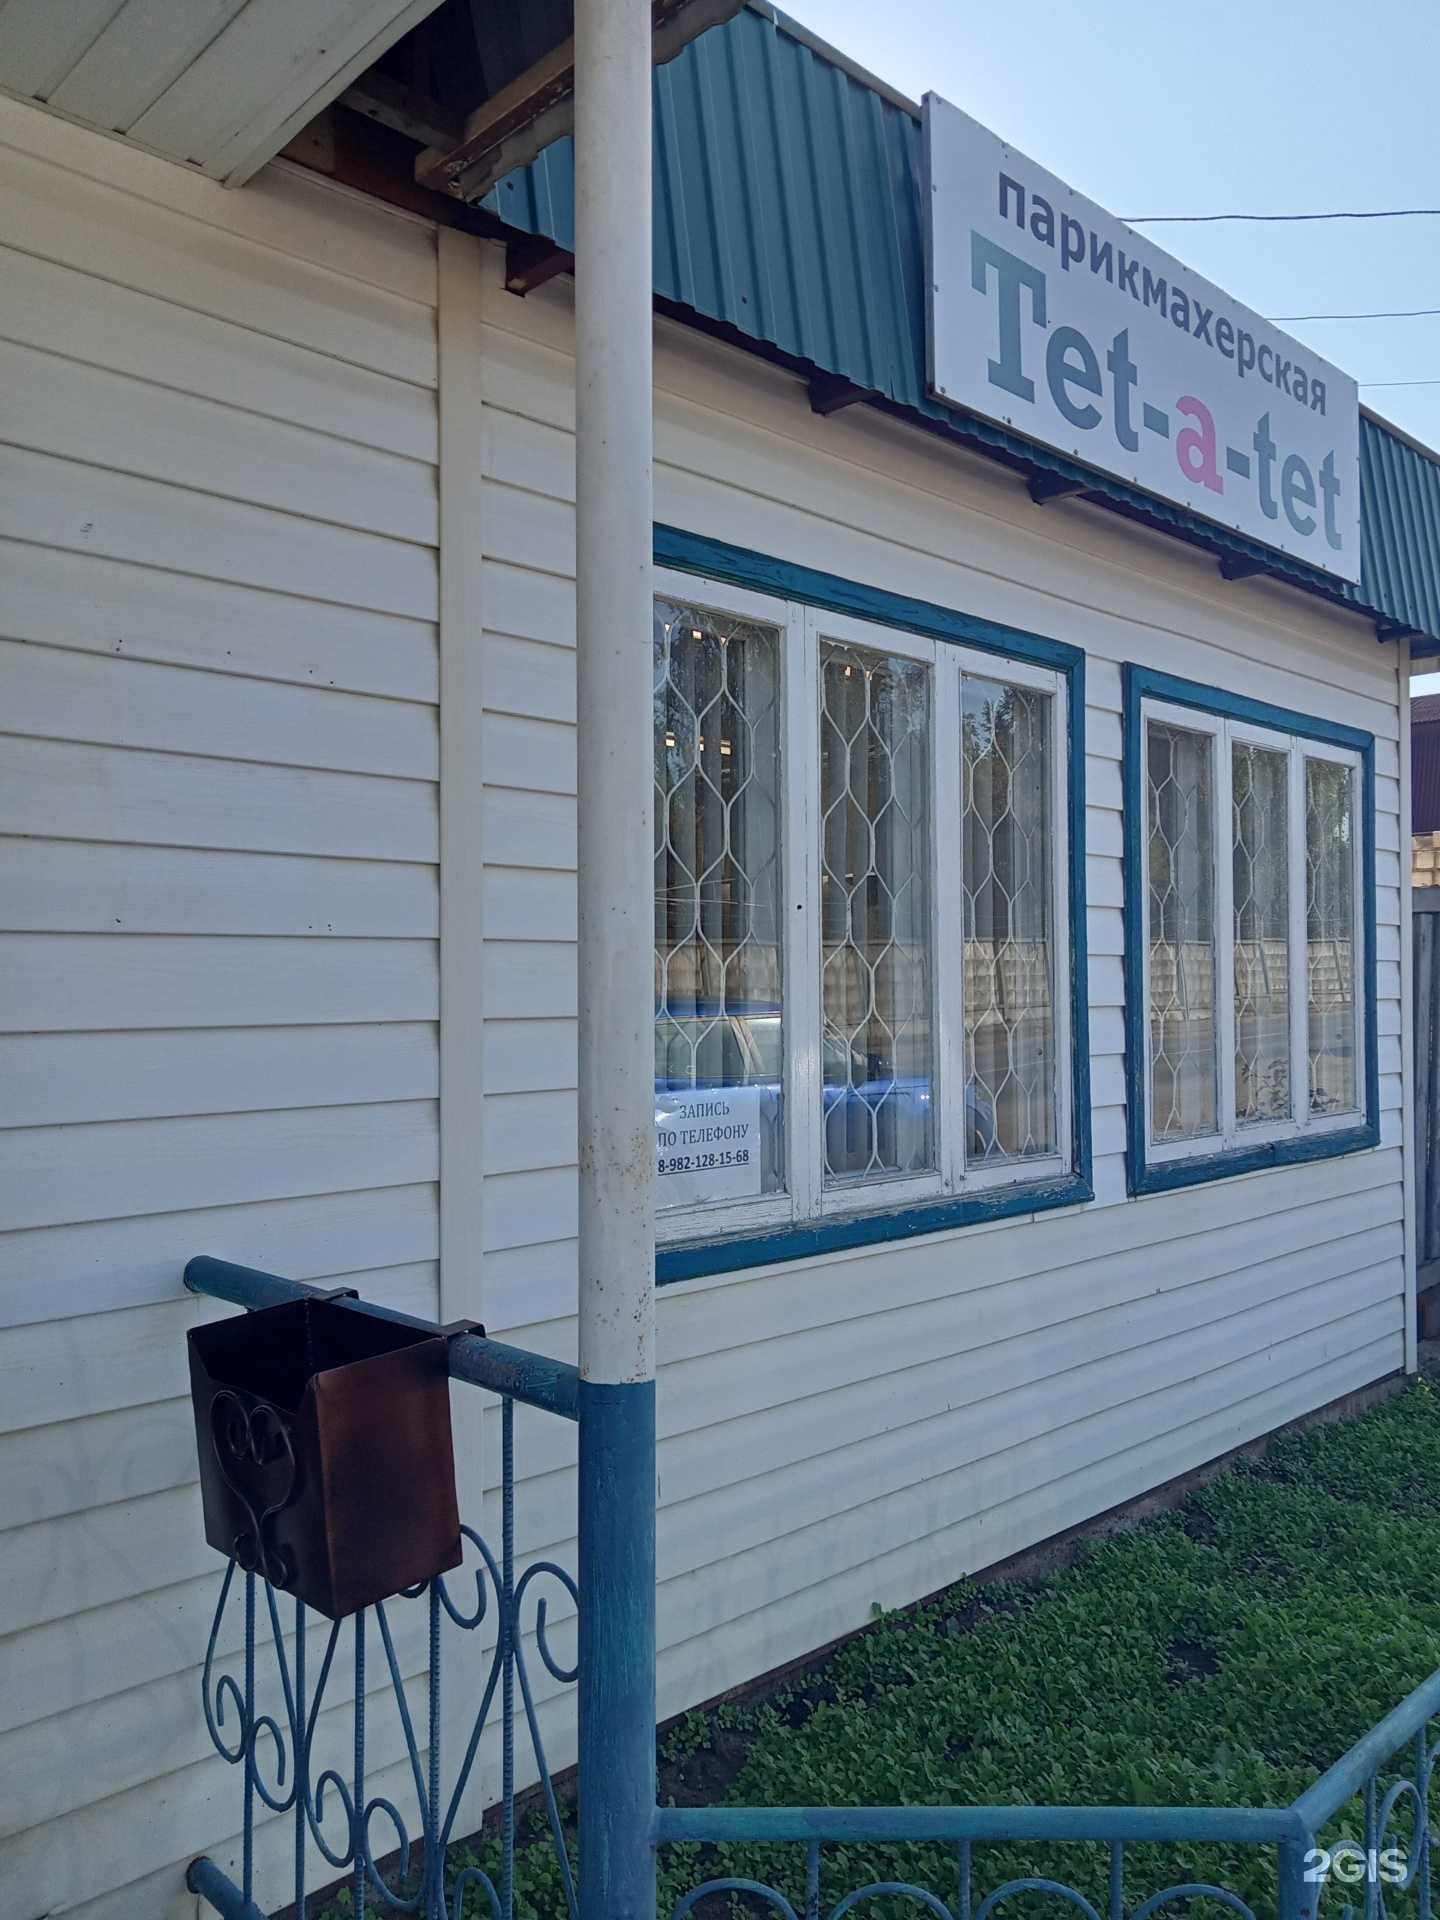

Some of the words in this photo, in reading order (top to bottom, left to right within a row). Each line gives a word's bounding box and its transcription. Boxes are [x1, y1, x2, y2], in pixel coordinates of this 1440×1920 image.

[999, 171, 1327, 416] парикмахерская
[970, 229, 1342, 550] Tet-a-tet
[679, 1101, 730, 1119] ЗАПИСЬ
[657, 1131, 677, 1148] ПО
[680, 1123, 749, 1145] ТЕЛЕФОНУ
[657, 1149, 749, 1174] 8-982-128-15-68
